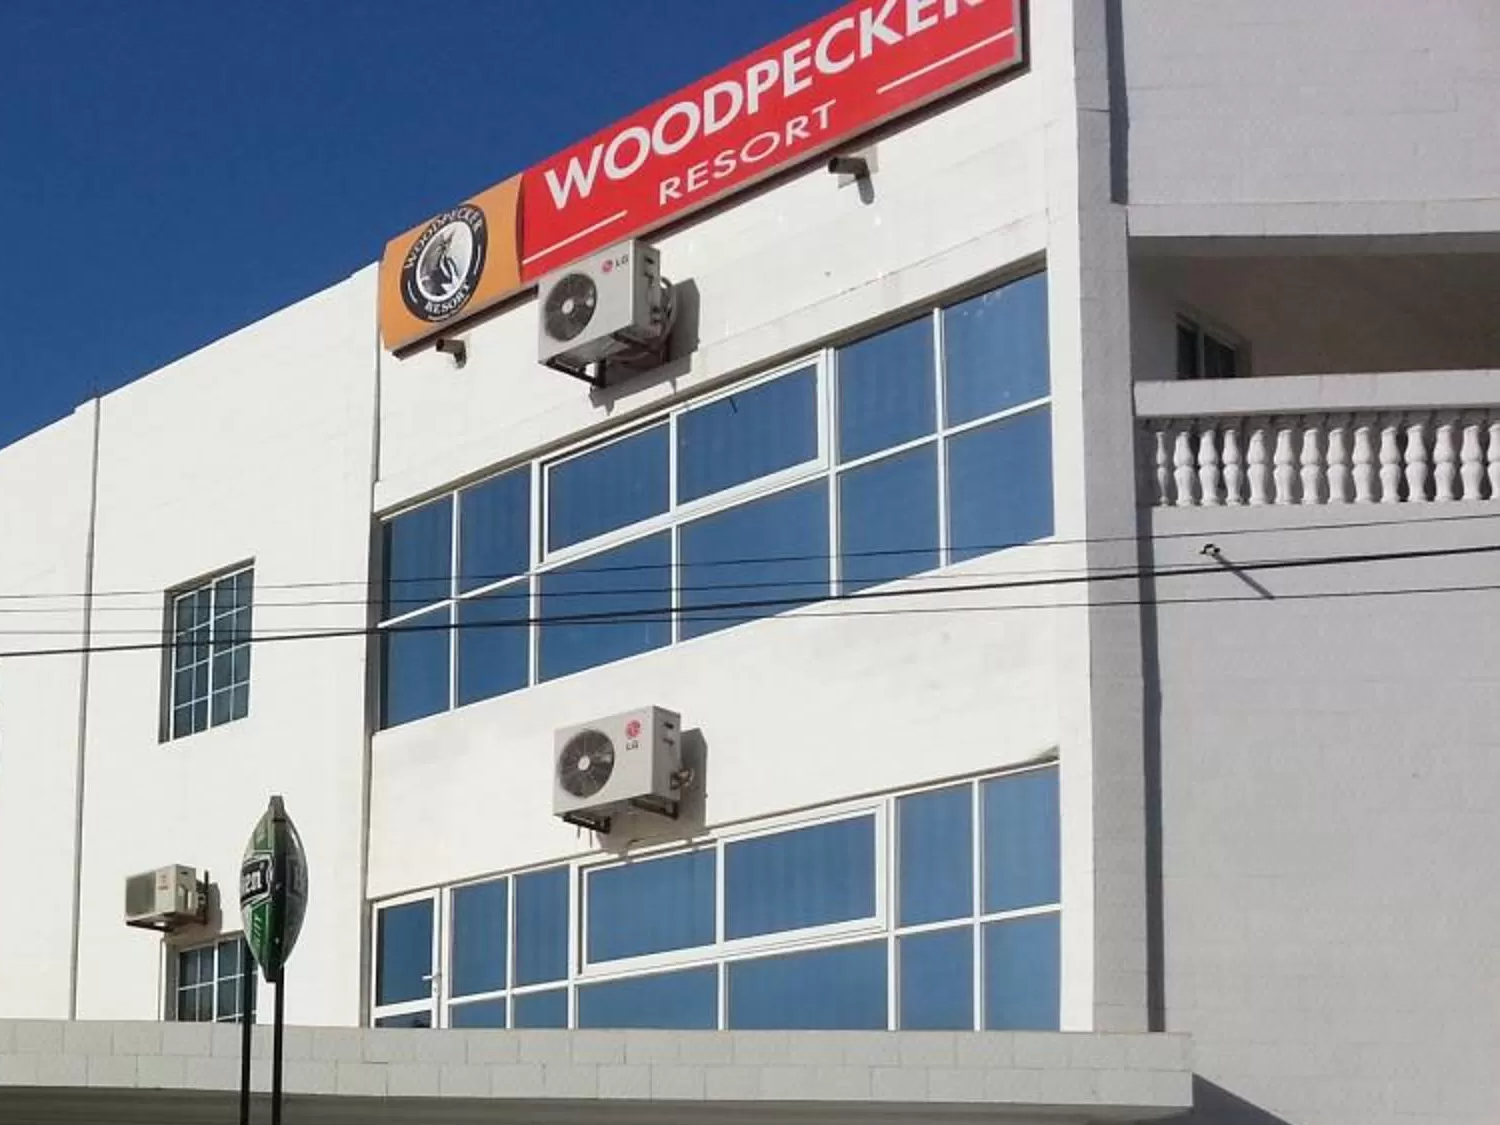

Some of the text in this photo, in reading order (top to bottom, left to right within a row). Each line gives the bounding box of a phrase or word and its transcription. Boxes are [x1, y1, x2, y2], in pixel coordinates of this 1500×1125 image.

[543, 0, 987, 210] WOODPECKE
[658, 98, 838, 206] RESORT
[424, 281, 471, 314] RESORT
